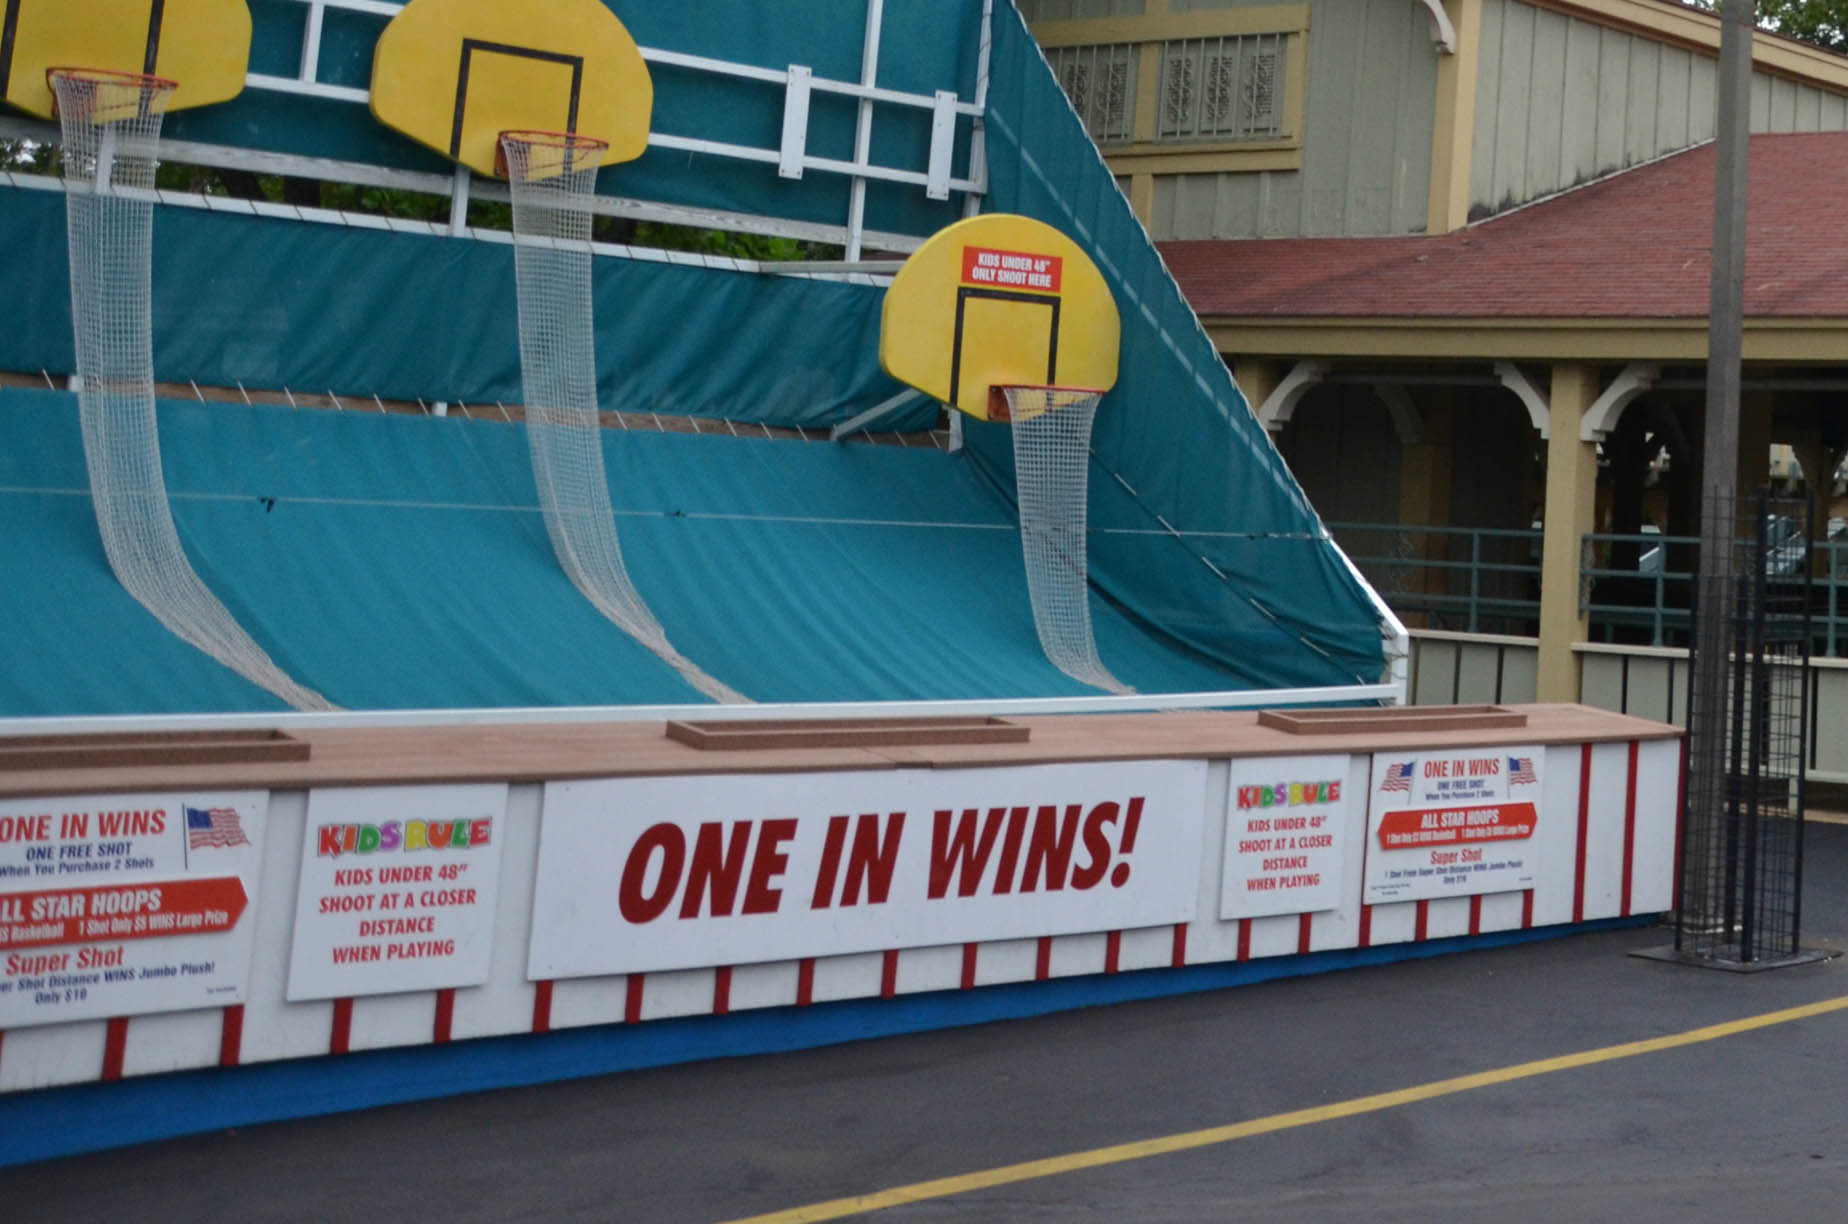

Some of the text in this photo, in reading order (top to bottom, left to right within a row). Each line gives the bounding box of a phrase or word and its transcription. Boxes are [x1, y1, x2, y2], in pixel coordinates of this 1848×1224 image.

[978, 252, 1000, 267] KIDS
[1001, 255, 1032, 271] UNDER
[972, 266, 1051, 288] ONLY SHOOT HERE
[1424, 758, 1499, 778] ONE IN WINS
[1237, 780, 1342, 811] KIDS RULE
[0, 809, 167, 843] ONE IN WINS
[1247, 819, 1270, 833] KIDS
[1274, 817, 1306, 831] UNDER
[1421, 809, 1499, 829] ALL STAR HOOPS
[318, 816, 492, 859] KIDS RULE
[1238, 834, 1333, 853] SHOOT AT A CLOSER
[26, 842, 133, 862] ONE FREE SHOT
[618, 796, 1146, 925] ONE IN WINS!
[1430, 848, 1483, 866] Super Shot
[0, 857, 154, 877] When You Purchase 2 Shots
[1262, 856, 1308, 871] DISTANCE
[334, 863, 468, 887] KIDS UNDER 48"
[1247, 873, 1320, 891] WHEN PLAYING
[0, 889, 162, 923] LL STAR HOOPS
[319, 888, 477, 914] SHOOT AT A CLOSER
[11, 922, 64, 940] Basketball
[80, 920, 84, 935] 1
[87, 918, 109, 935] Shot
[111, 917, 132, 934] Only
[149, 913, 175, 929] WINS
[176, 911, 203, 928] Large
[204, 909, 228, 925] Prize
[359, 916, 435, 937] DISTANCE
[6, 946, 124, 976] Super Shot
[332, 939, 455, 964] WHEN PLAYING
[17, 976, 45, 991] Shot
[48, 971, 100, 987] Distance
[104, 968, 136, 983] WINS
[139, 965, 177, 979] Jumbo
[35, 988, 87, 1005] Only $10
